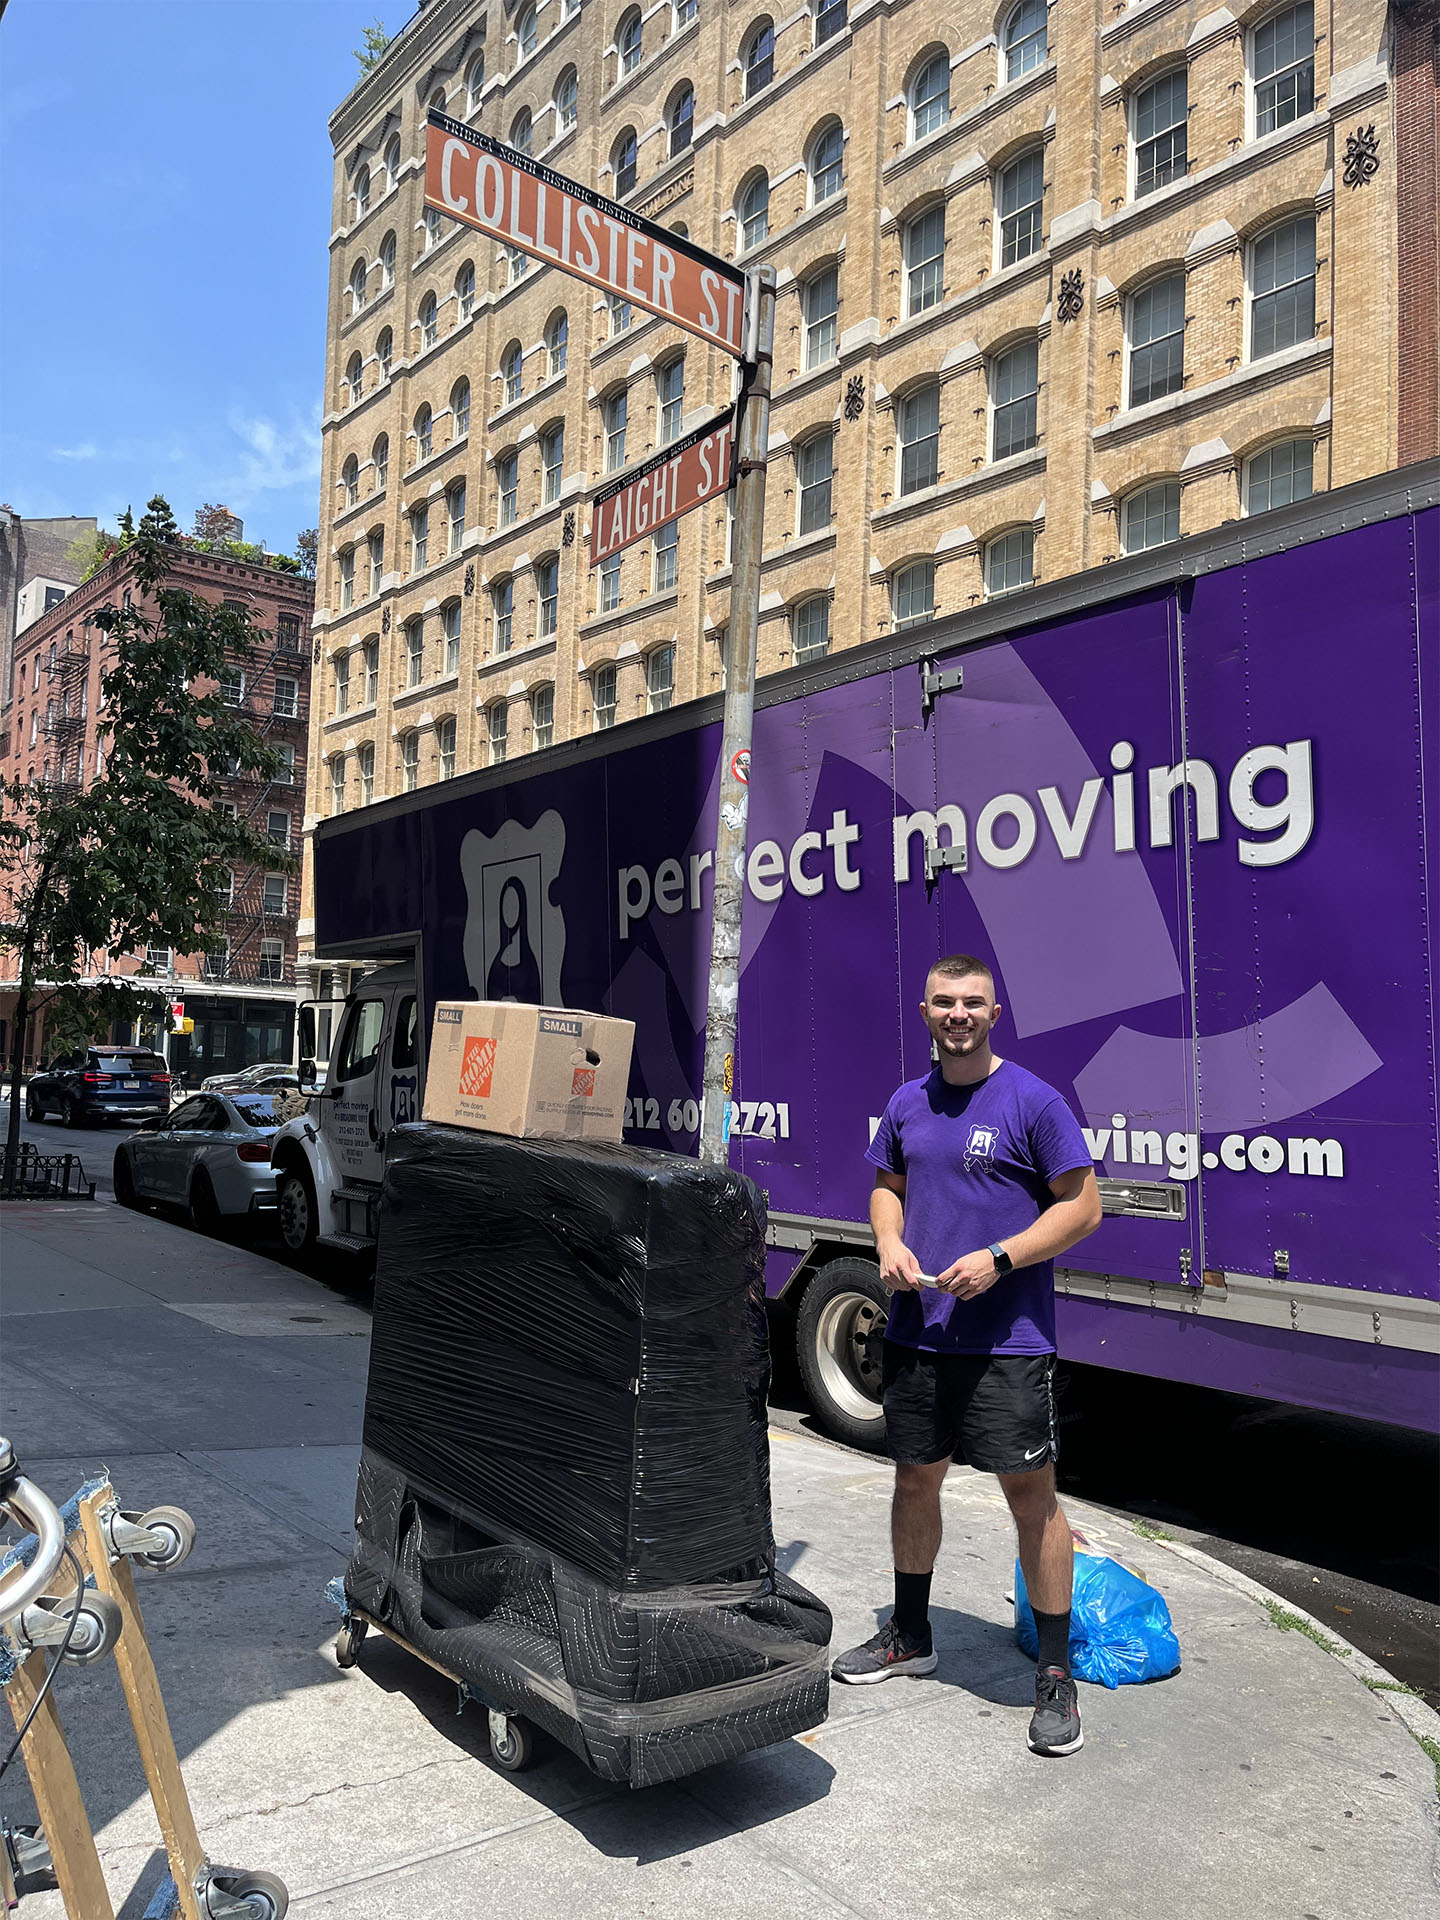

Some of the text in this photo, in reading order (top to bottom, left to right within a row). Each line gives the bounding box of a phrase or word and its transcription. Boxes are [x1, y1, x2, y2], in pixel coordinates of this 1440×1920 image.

[444, 119, 643, 229] TRIBECA NORTH HISTORIC DISTRICT
[441, 138, 740, 346] COLLISTER ST
[597, 426, 730, 557] LAIGHT ST
[618, 739, 1314, 939] perect moving
[439, 1011, 460, 1021] SMALL
[543, 1020, 578, 1033] SMALL
[624, 1097, 660, 1129] 212
[730, 1101, 789, 1138] 2721
[1081, 1113, 1344, 1180] ving.com
